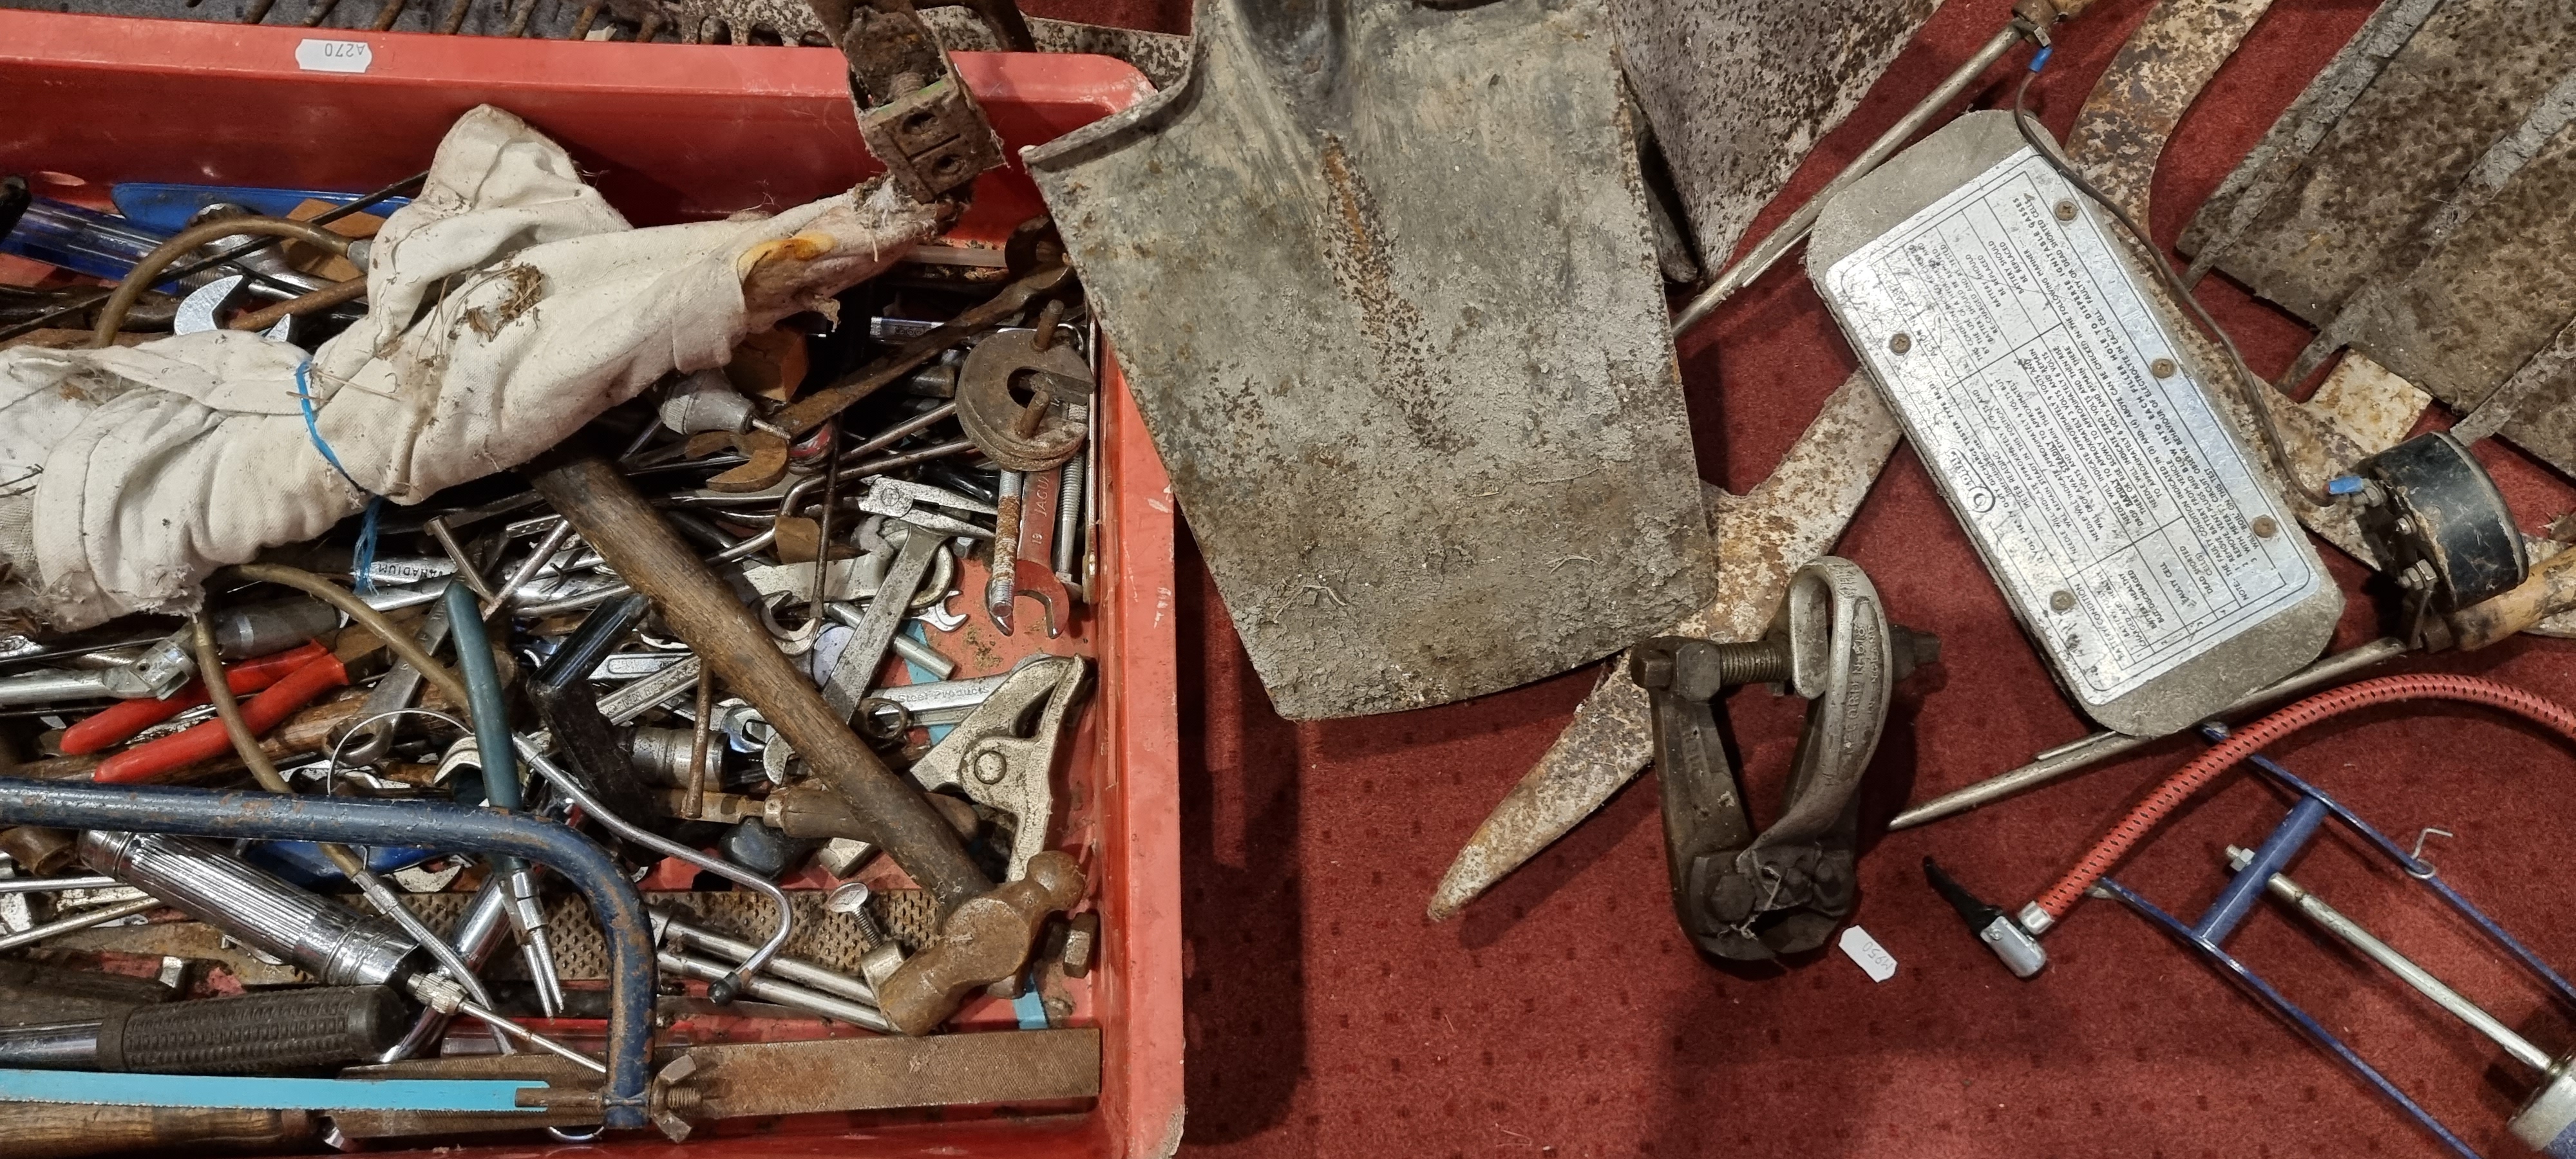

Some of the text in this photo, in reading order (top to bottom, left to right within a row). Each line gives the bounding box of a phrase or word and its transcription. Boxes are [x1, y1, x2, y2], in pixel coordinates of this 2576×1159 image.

[324, 42, 366, 57] A270
[2011, 196, 2035, 229] GASSES
[2036, 218, 2059, 249] SHORTED
[1987, 239, 2025, 294] BATTERY SHOULD
[1998, 240, 2022, 274] REPLACED
[2022, 248, 2044, 277] MANNER
[2032, 230, 2066, 277] IGNITABLE
[2055, 248, 2071, 267] DEAD
[1938, 243, 1999, 334] RE-CHARGED RE-TESTED
[1964, 252, 2002, 308] BATTERY SHOULD
[1976, 254, 2007, 296] BE REPLACED
[2074, 278, 2094, 304] FAULTY
[1926, 257, 1975, 330] USE HYDROMETER
[1931, 283, 1952, 310] SHOULD
[2040, 276, 2069, 316] FOLLOWING
[2063, 279, 2092, 319] DISPERSE
[1889, 286, 1938, 357] ACTION NECESSARY
[1947, 309, 1975, 346] CONDITION
[1956, 288, 1994, 343] BATTERY SHOULD
[2099, 336, 2119, 361] HOLE
[2104, 325, 2119, 344] EACH
[2116, 344, 2126, 354] IN
[1971, 346, 1984, 362] THIS
[2079, 339, 2103, 370] CHECKED
[2105, 380, 2119, 396] CAN
[2116, 363, 2139, 393] FILLER
[2121, 353, 2153, 397] ELECTROLYTE
[2063, 345, 2156, 487] APPROXIMATELY VOLTS REMAIN THERE
[2116, 395, 2134, 419] ABOVE
[2136, 394, 2156, 420] EACH
[2027, 347, 2144, 527] DROP RAPIDLY APPROXIMATELY VOLTS REMAIN
[2040, 351, 2147, 515] THERE RISE SLOWLY APPROXIMATELY VOLTS
[2052, 345, 2159, 509] NEEDLE WILL INDICATE ZERO VOLTS AND THEN RISE
[2154, 422, 2172, 446] INTO
[2155, 408, 2183, 446] BEHAVIOUR
[1971, 438, 1983, 451] use
[2005, 377, 2105, 530] WILL DROP AWAY STEADILY TO APPROXIMATELY
[2032, 373, 2132, 525] NEEDLE WILL INDICATE APPROXIMATELY VOLTS
[2033, 405, 2090, 489] VOLTS REMAIN THERE
[2169, 446, 2190, 473] BLOW
[2179, 445, 2201, 475] OBSERVE
[1939, 400, 2045, 564] 12 VOLT DUTY DISCHARGE TESTER TYPE
[1944, 447, 1998, 518] OLDHAM
[1971, 388, 2079, 554] NEEDLE WILL INDICATE APPROXIMATELY VOLTS AND
[1991, 449, 2032, 509] METER READING
[1993, 406, 2073, 528] WILL REMAIN STEADY IN THIS POSITION
[2003, 391, 2101, 542] NEEDLE WILL INDICATE APPROXIMATELY VOLTS
[2159, 464, 2185, 500] INDICATED
[2165, 458, 2186, 485] VEHICLE
[2186, 474, 2201, 491] AND
[2203, 466, 2217, 482] TEST
[1035, 471, 1051, 518] JAGUA
[2183, 485, 2199, 506] FROM
[2197, 490, 2214, 512] PLUGS
[2213, 482, 2227, 498] THIS
[2181, 499, 2209, 537] CONDITION
[2195, 506, 2218, 535] BATTERY
[2210, 511, 2226, 531] VENT
[2222, 513, 2240, 535] METER
[1031, 532, 1043, 545] 19
[2205, 538, 2225, 562] FAULTY
[2214, 535, 2235, 563] REMOVE
[2222, 530, 2244, 558] REMOVE
[2236, 535, 2252, 554] WITH
[2245, 532, 2260, 550] WILL
[378, 563, 444, 578] VANADIUM
[2178, 544, 2213, 594] DEAD SHORTED
[2193, 551, 2213, 576] CELL(S)
[2221, 562, 2234, 576] THE
[2126, 569, 2155, 609] DISCHARGED
[2158, 561, 2189, 604] FAULTY CELL
[2095, 570, 2147, 647] CHARGED HEALTHY
[2096, 588, 2130, 637] BATTERY FULLY
[2117, 571, 2157, 630] BATTERY HEALTHY
[2073, 582, 2125, 659] BATTERY CONDITION
[898, 686, 990, 702] Steel Products
[1861, 939, 1893, 972] M950
